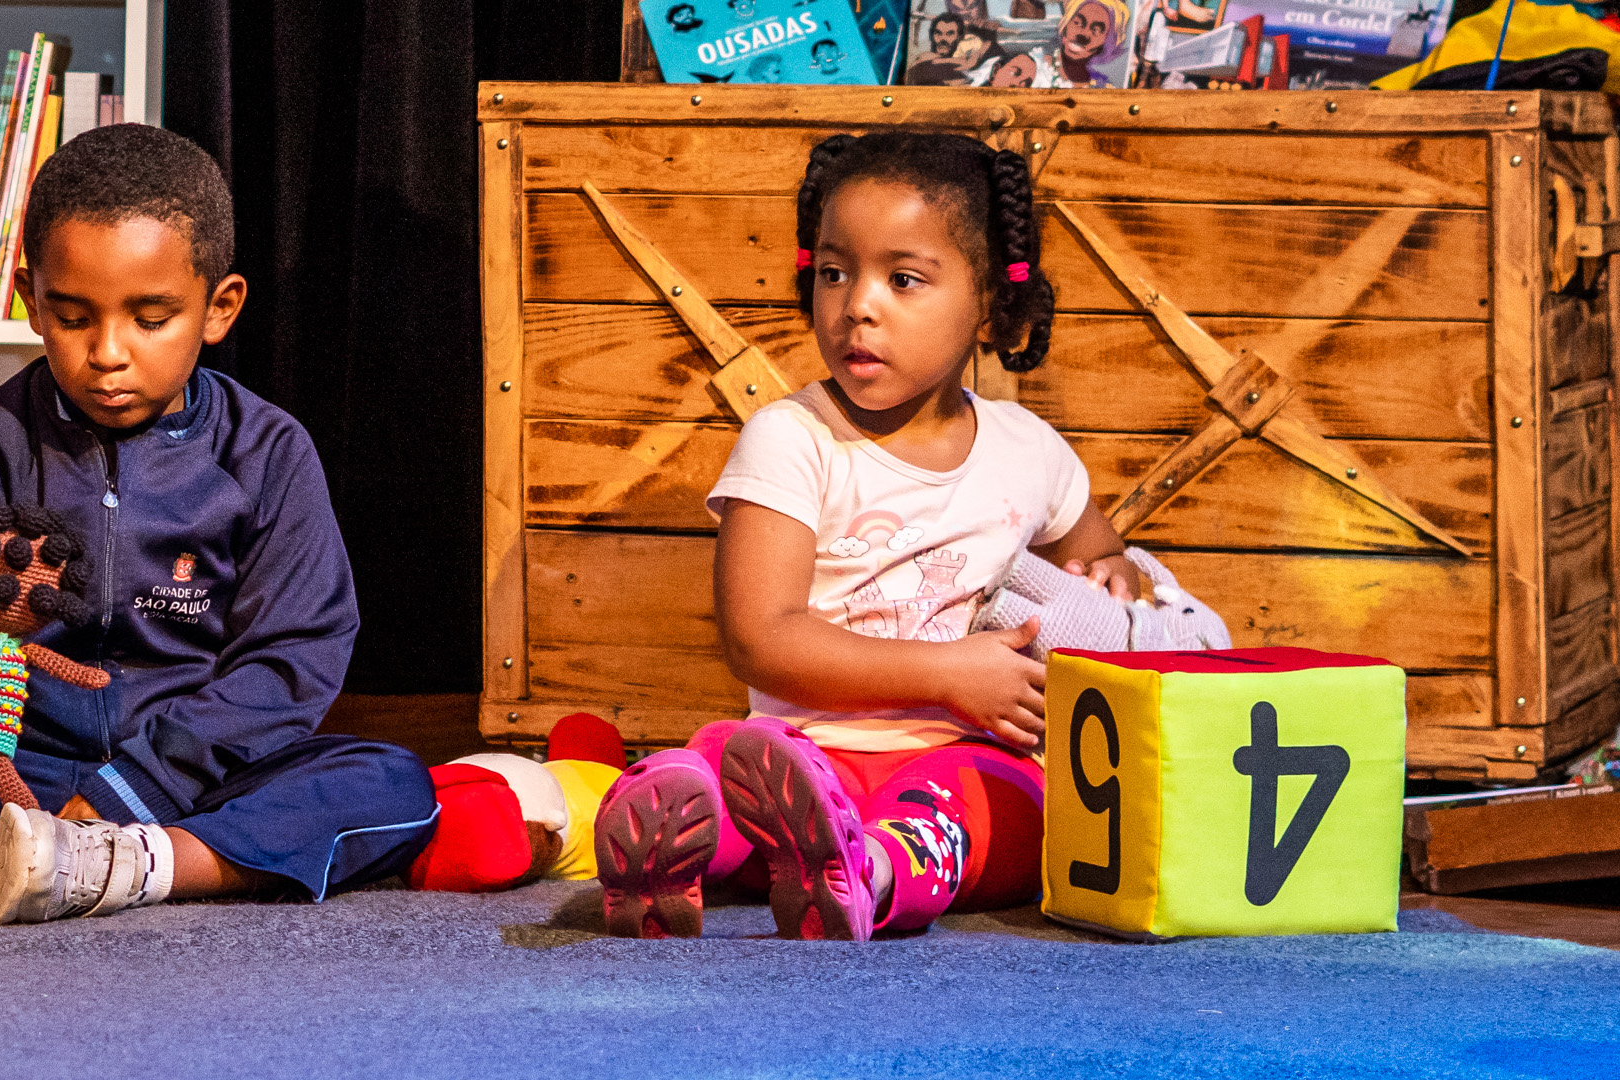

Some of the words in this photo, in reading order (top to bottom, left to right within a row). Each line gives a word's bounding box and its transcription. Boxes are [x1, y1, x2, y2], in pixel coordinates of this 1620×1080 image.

[697, 12, 818, 64] OUSADAS
[1284, 10, 1315, 24] em
[1321, 9, 1393, 33] Cordel
[151, 585, 192, 599] CIDADE
[194, 587, 209, 599] DE
[168, 597, 211, 615] PAULO
[1068, 687, 1121, 895] 5
[1232, 700, 1351, 906] 4
